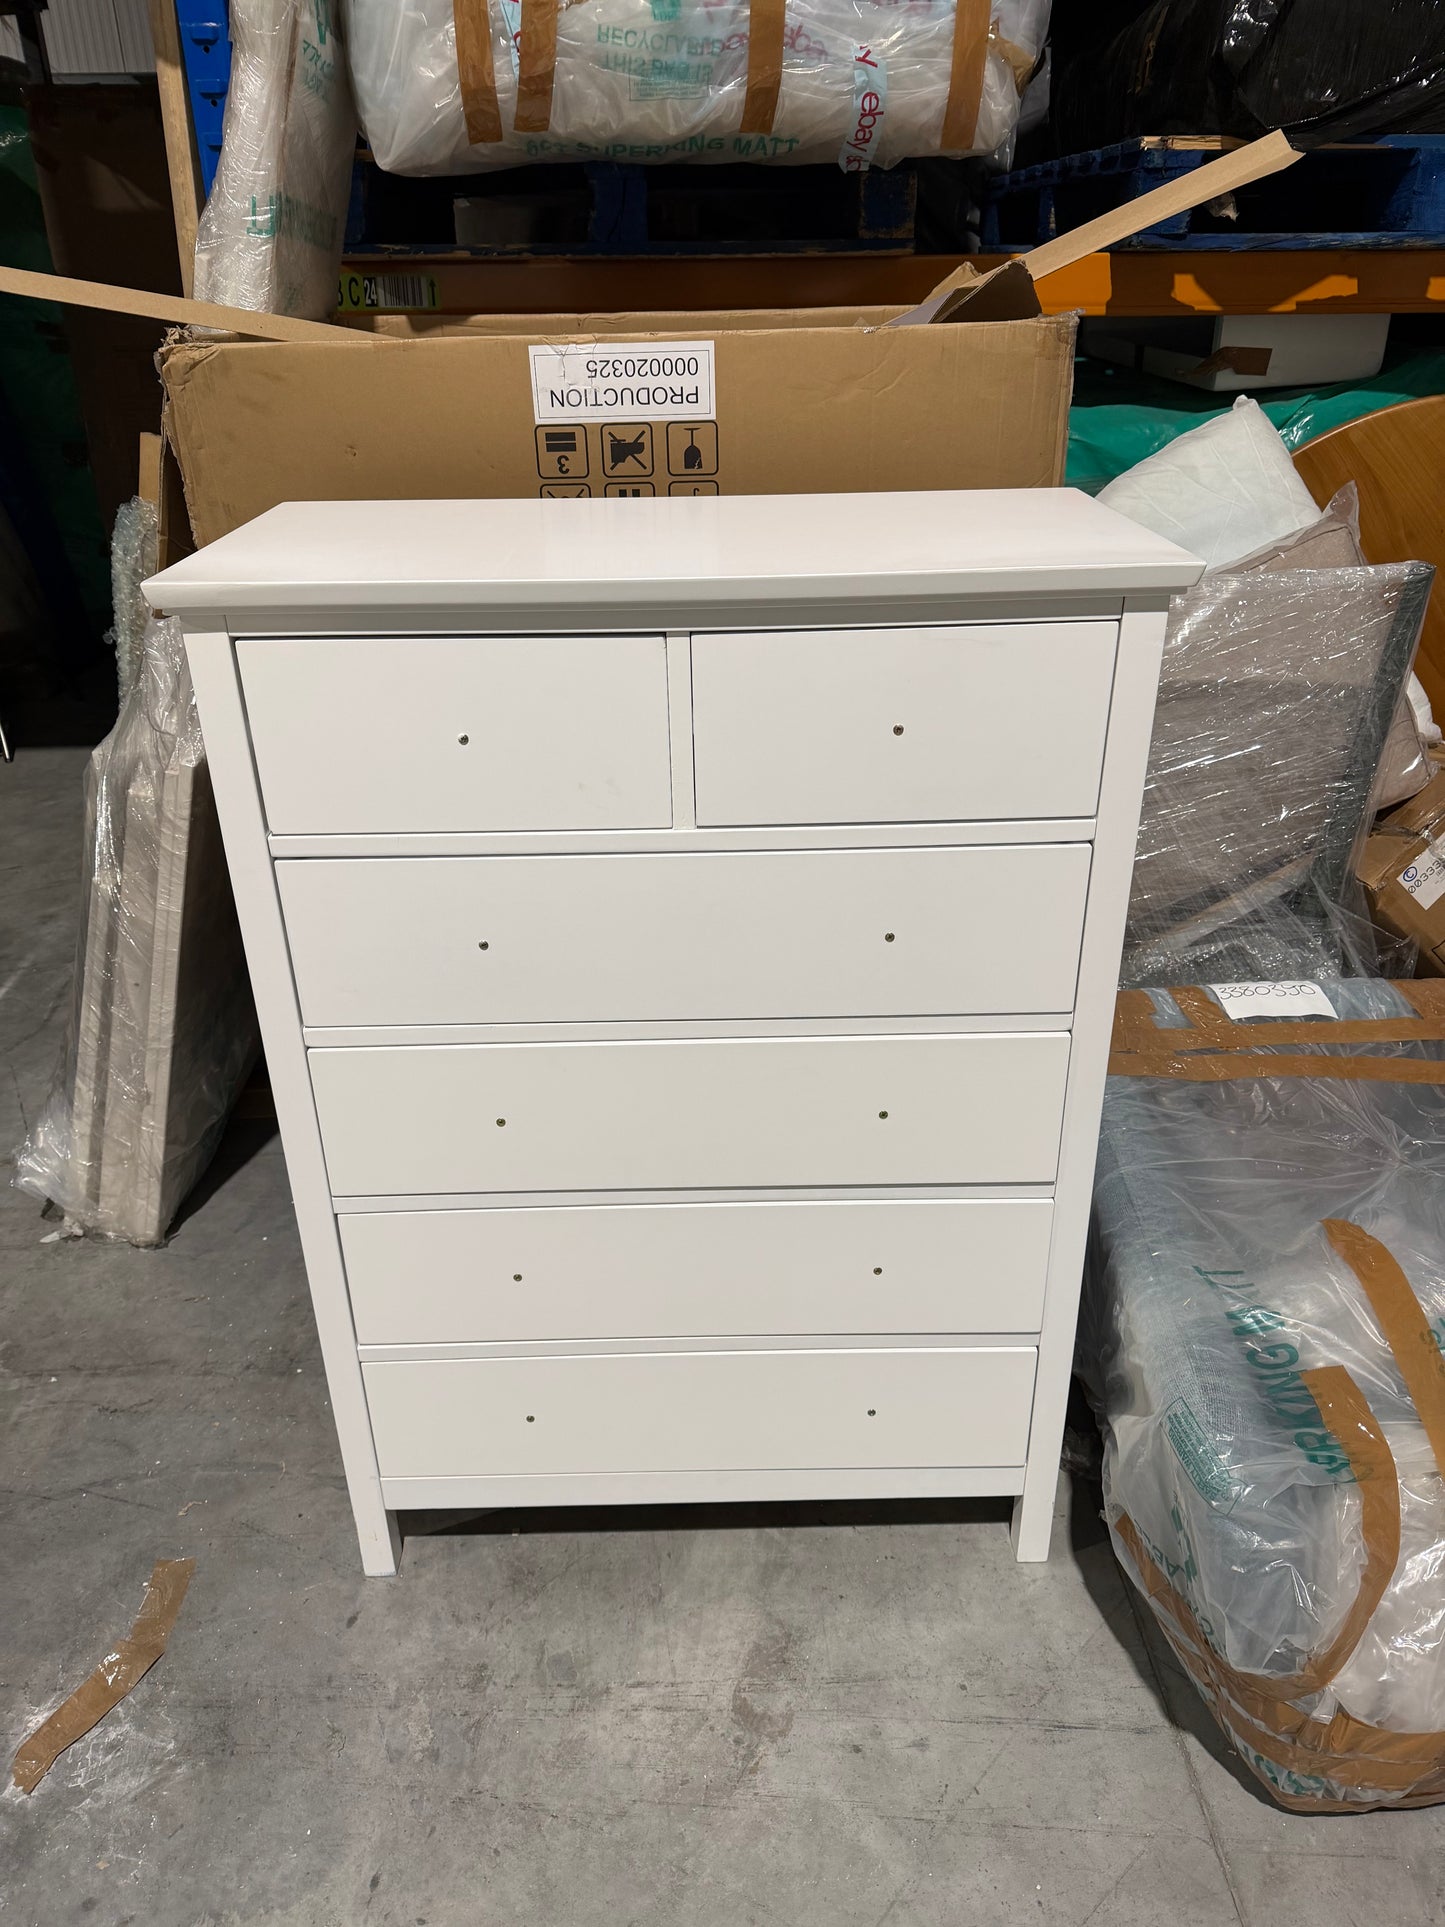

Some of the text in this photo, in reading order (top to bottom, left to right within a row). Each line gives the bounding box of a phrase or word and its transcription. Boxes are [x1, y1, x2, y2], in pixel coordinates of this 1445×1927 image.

[846, 91, 884, 153] ebay
[733, 136, 800, 157] MATT
[363, 279, 378, 305] 24
[585, 357, 699, 378] 000020325
[550, 386, 699, 408] PRODUCTION
